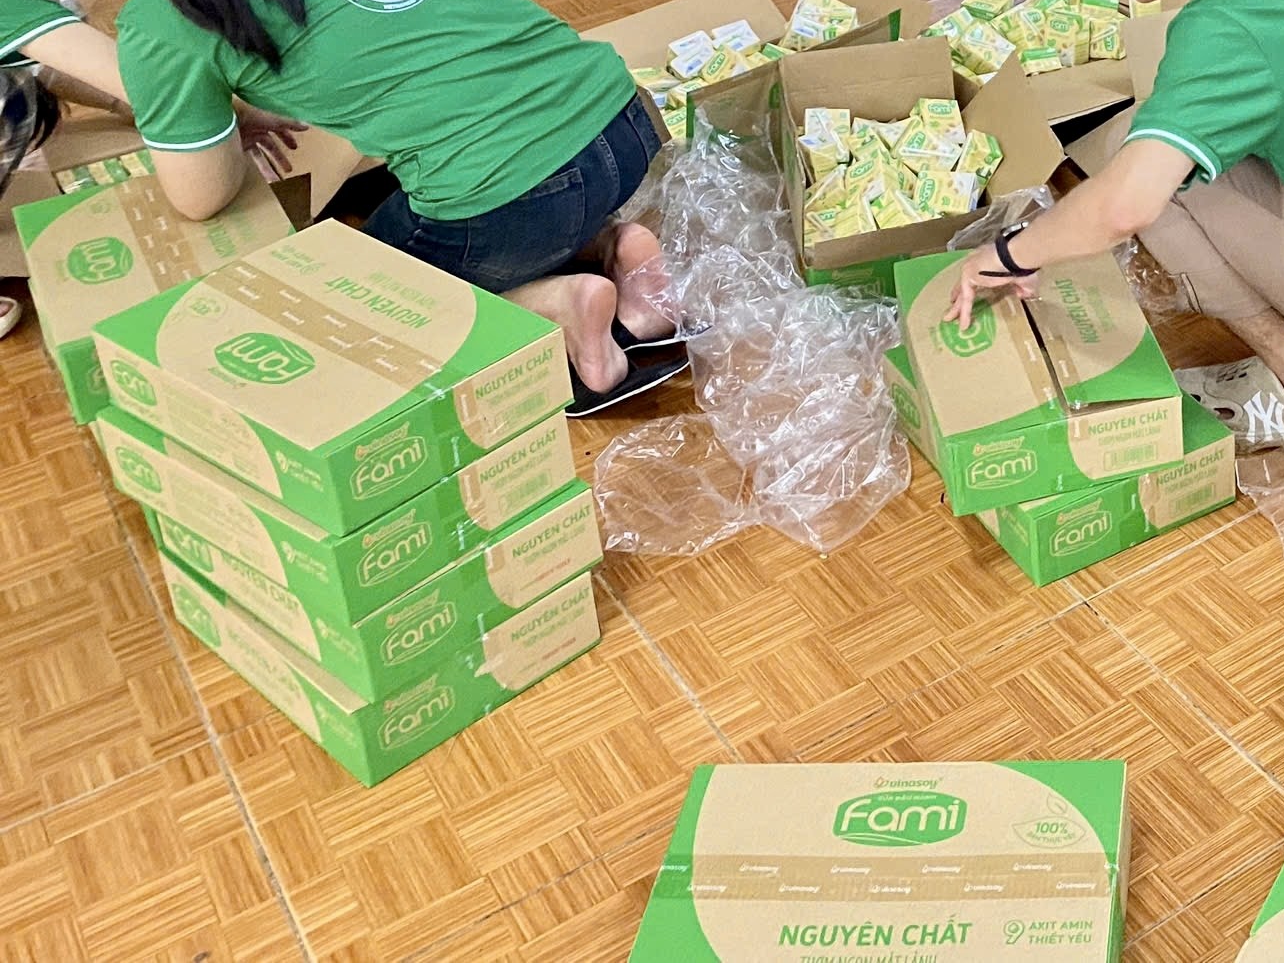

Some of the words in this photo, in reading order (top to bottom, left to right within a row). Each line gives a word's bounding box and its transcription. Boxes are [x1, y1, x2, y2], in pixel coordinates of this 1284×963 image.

[222, 337, 311, 383] Fami
[475, 364, 523, 399] NGUYÊN
[526, 347, 555, 372] CHẤT
[1088, 415, 1136, 437] NGUYÊN
[1139, 408, 1169, 424] CHẤT
[356, 439, 422, 494] Fami
[479, 446, 527, 484] NGUYÊN
[529, 428, 557, 455] CHẤT
[970, 455, 1033, 485] Fami
[1156, 465, 1198, 486] NGUYÊN
[1199, 448, 1225, 468] CHẤT
[512, 525, 561, 558] NGUYÊN
[1053, 514, 1109, 551] Fami
[362, 524, 428, 580] Fami
[386, 607, 451, 661] Fami
[384, 692, 450, 746] Fami
[840, 798, 960, 832] Fami
[1035, 821, 1068, 835] 100%
[778, 921, 898, 947] NGUYÊN
[902, 913, 973, 946] CHẤT
[1003, 919, 1026, 946] 9
[1029, 921, 1057, 931] AXIT
[1060, 920, 1093, 930] AMIN
[1028, 932, 1065, 945] THIẾT
[1068, 931, 1093, 943] YẾU
